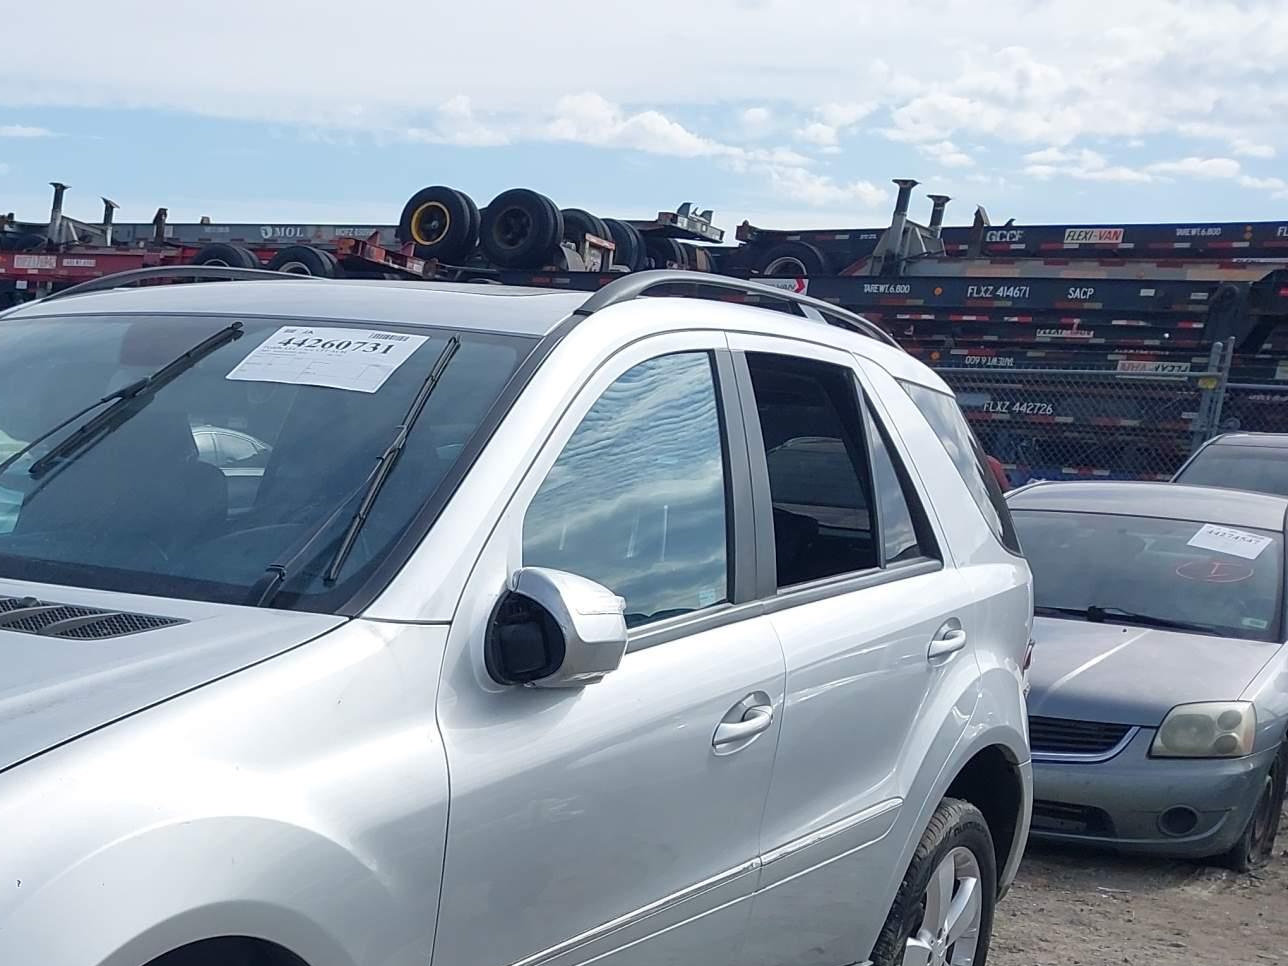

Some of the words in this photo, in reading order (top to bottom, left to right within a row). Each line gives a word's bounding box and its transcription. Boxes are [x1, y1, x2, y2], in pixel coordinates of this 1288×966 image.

[275, 227, 304, 238] MOL
[1065, 230, 1123, 242] FLEXI-VAN
[967, 285, 993, 298] FLXZ
[996, 286, 1030, 298] 414671
[1067, 287, 1094, 299] SACP
[278, 336, 396, 355] 44260731
[983, 400, 1010, 412] FLXZ
[1012, 402, 1053, 415] 442726
